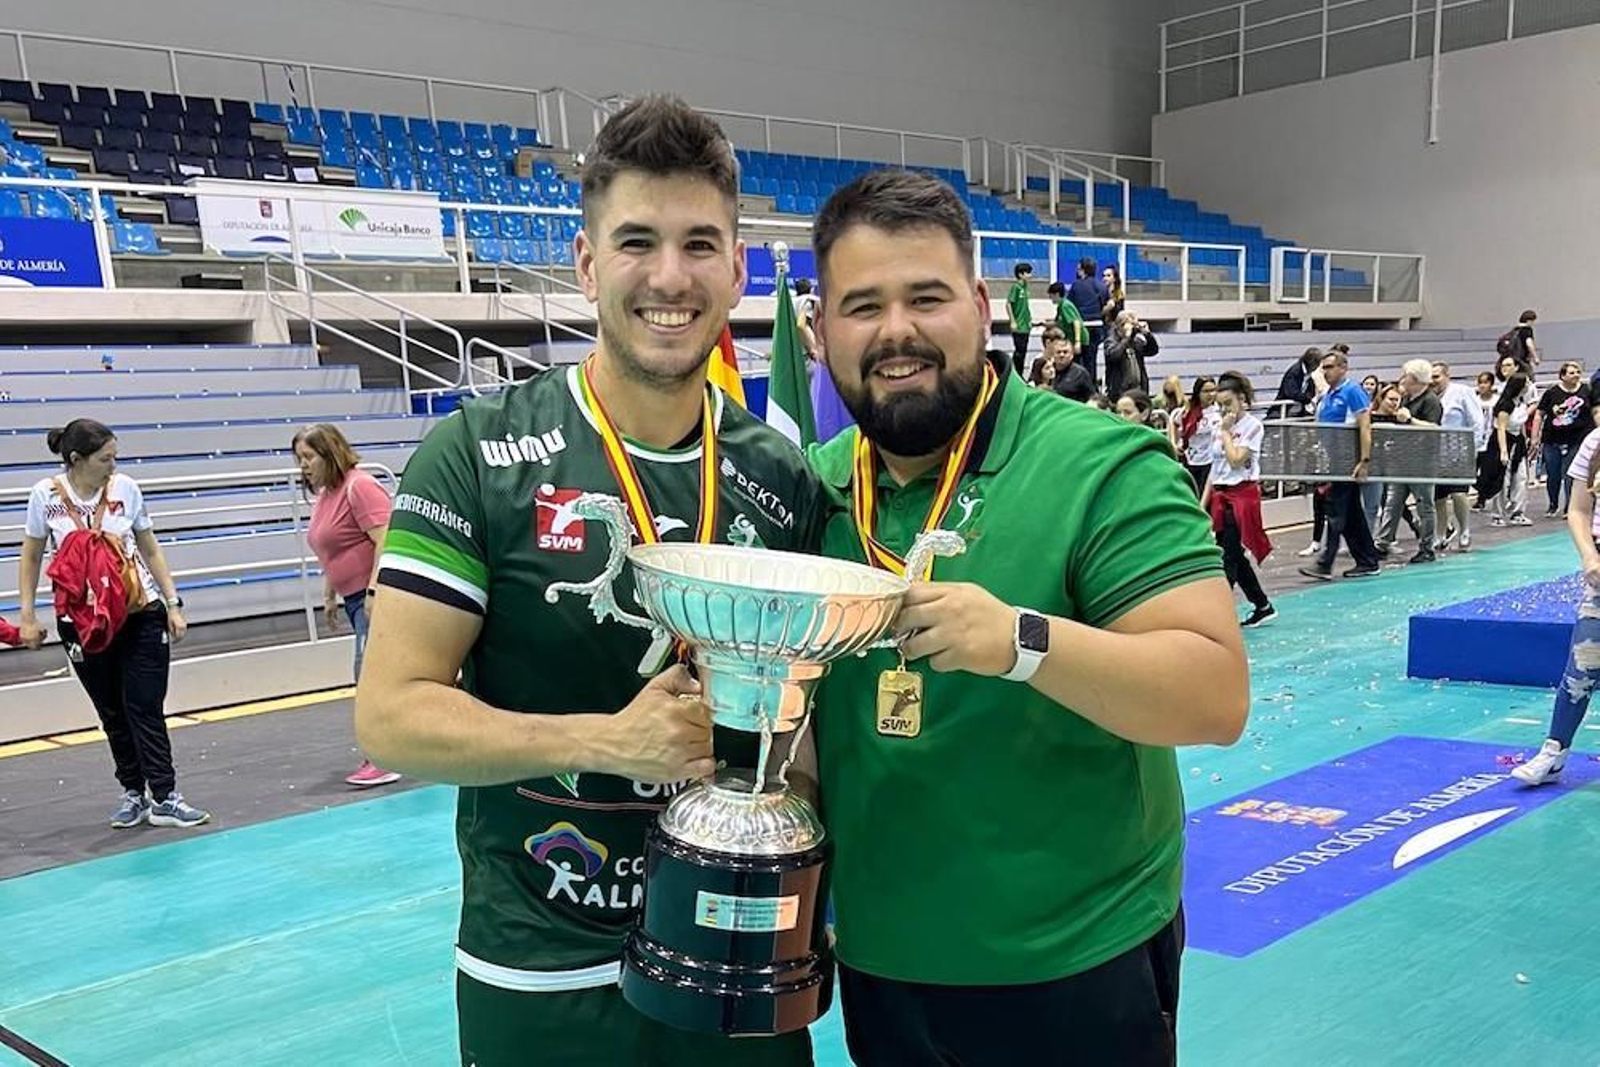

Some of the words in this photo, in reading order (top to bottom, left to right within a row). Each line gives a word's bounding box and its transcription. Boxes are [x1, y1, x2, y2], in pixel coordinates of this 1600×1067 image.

[367, 222, 402, 237] Unicaja
[403, 224, 431, 235] Banco
[0, 259, 15, 271] DE
[17, 259, 66, 272] ALMERÍA
[539, 535, 583, 551] SVM
[1223, 823, 1395, 895] DIPUTACIÓN
[1374, 809, 1427, 827] DE
[1409, 772, 1513, 812] ALMERÍA
